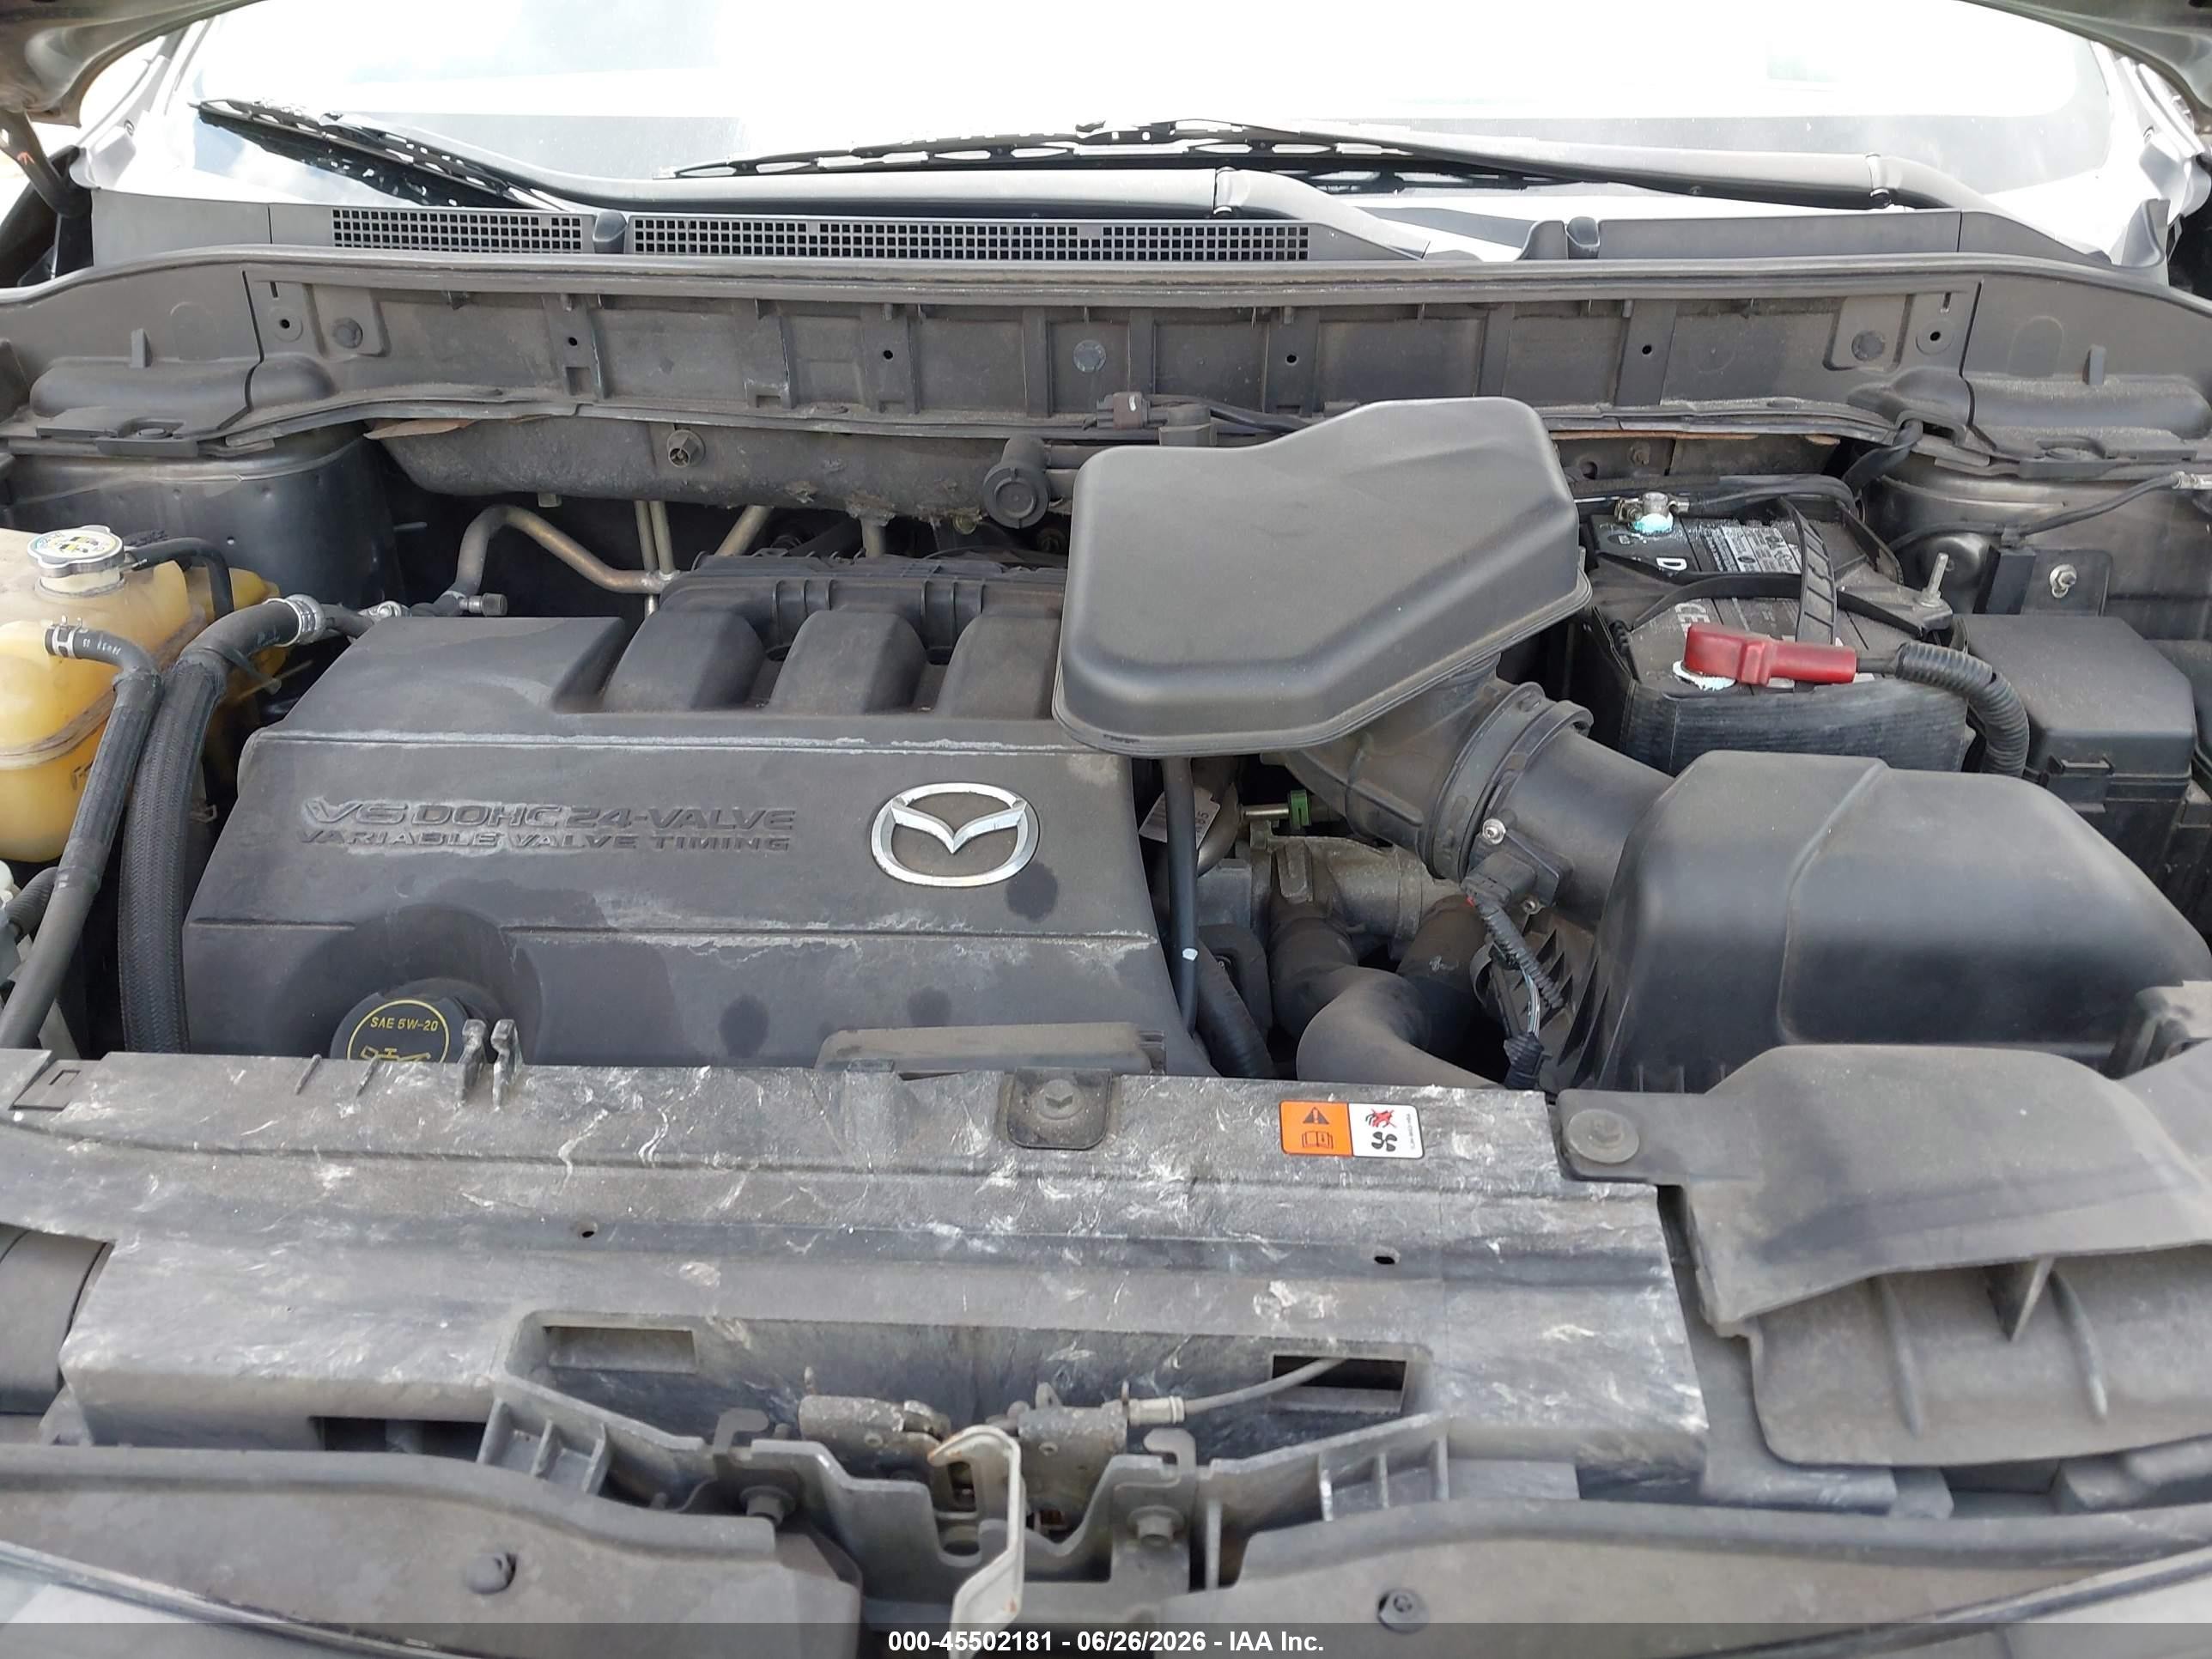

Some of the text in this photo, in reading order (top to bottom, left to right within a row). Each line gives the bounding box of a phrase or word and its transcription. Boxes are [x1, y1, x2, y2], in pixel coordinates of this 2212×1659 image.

[305, 798, 796, 830] V6 DOHC 24-VALVE
[301, 830, 790, 852] VARIABLE VALVE TIMING
[370, 1016, 439, 1031] SAE 5W-20
